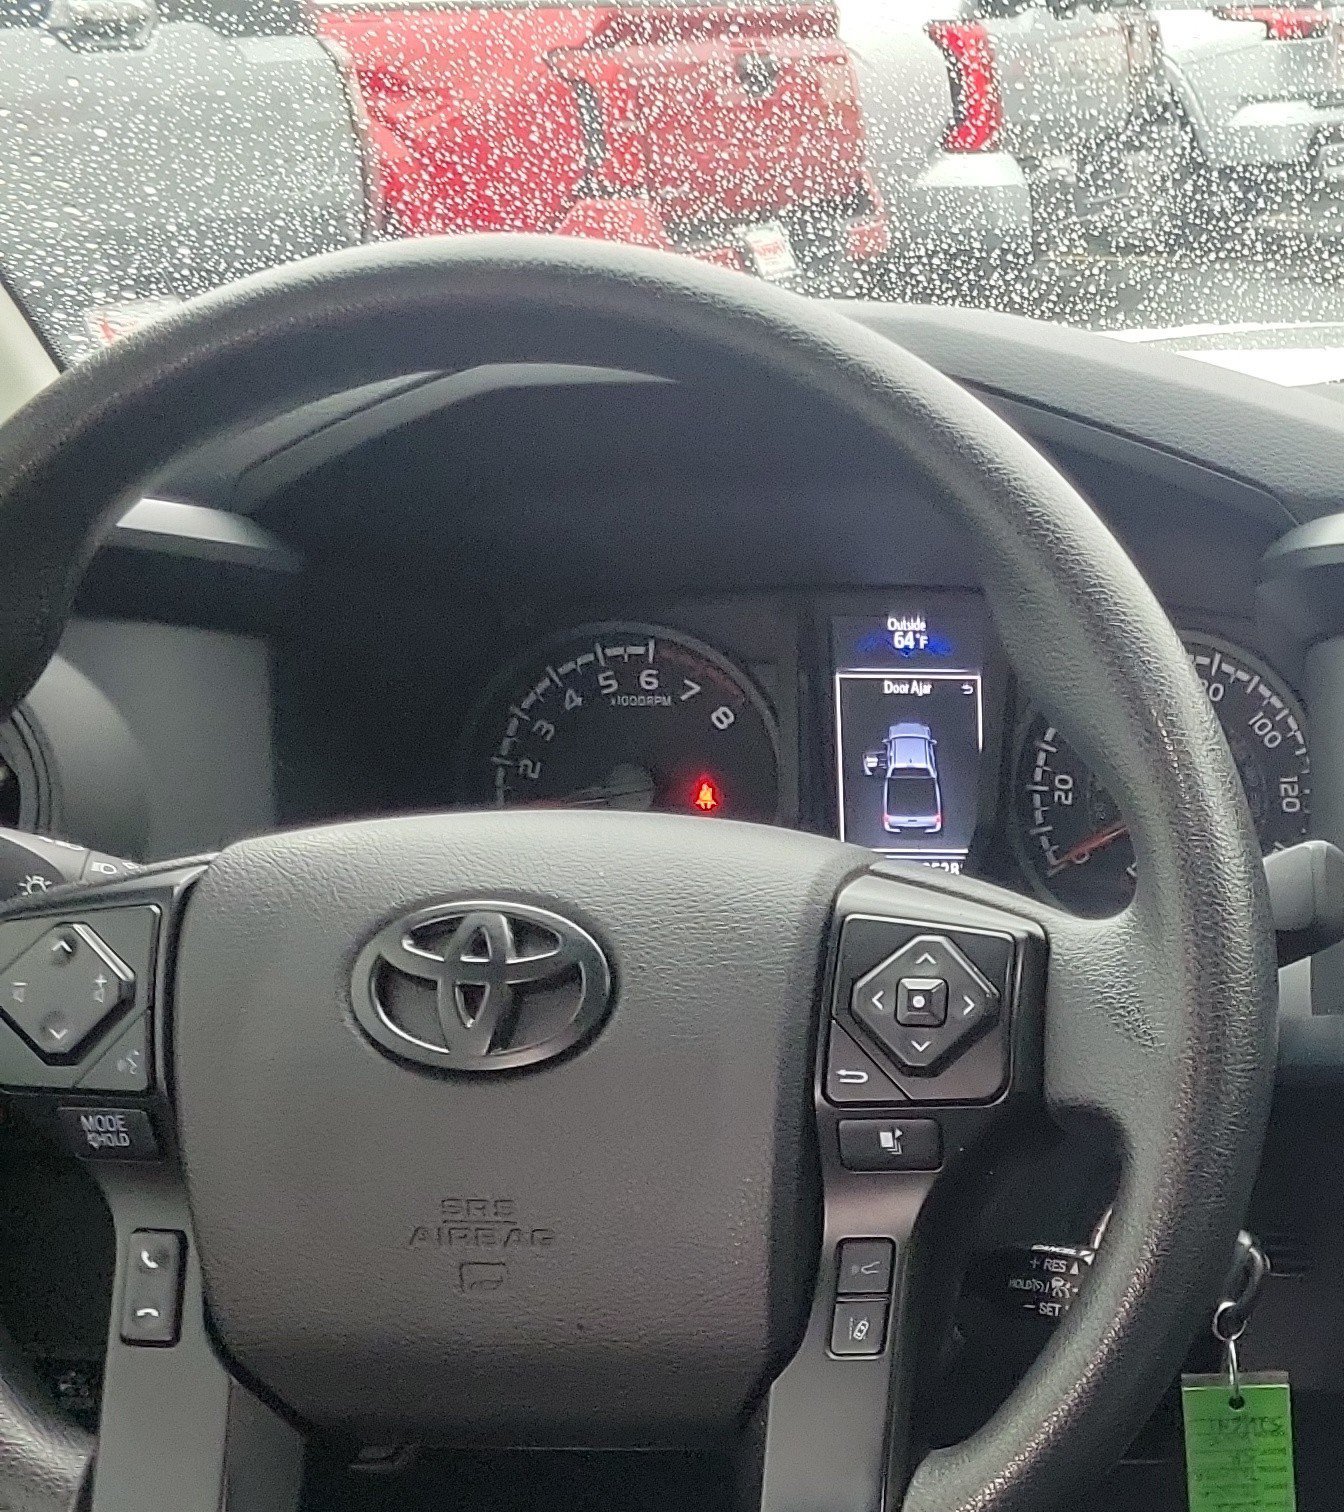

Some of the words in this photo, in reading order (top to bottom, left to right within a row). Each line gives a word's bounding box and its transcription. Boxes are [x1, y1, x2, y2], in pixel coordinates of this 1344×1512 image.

[887, 616, 926, 631] Outside
[598, 671, 619, 694] 5
[640, 670, 659, 691] 6
[680, 679, 701, 701] 7
[884, 680, 909, 694] Door
[911, 680, 932, 696] Ajar
[564, 689, 584, 710] 4
[711, 706, 735, 730] 8
[532, 720, 555, 740] 3
[1248, 711, 1282, 749] 100
[518, 759, 541, 779] 2
[1054, 774, 1073, 805] 20
[1280, 776, 1300, 813] 120
[81, 1114, 129, 1131] MODE
[408, 1225, 555, 1247] AIRBAG
[1043, 1259, 1068, 1273] RES
[1038, 1302, 1062, 1317] SET
